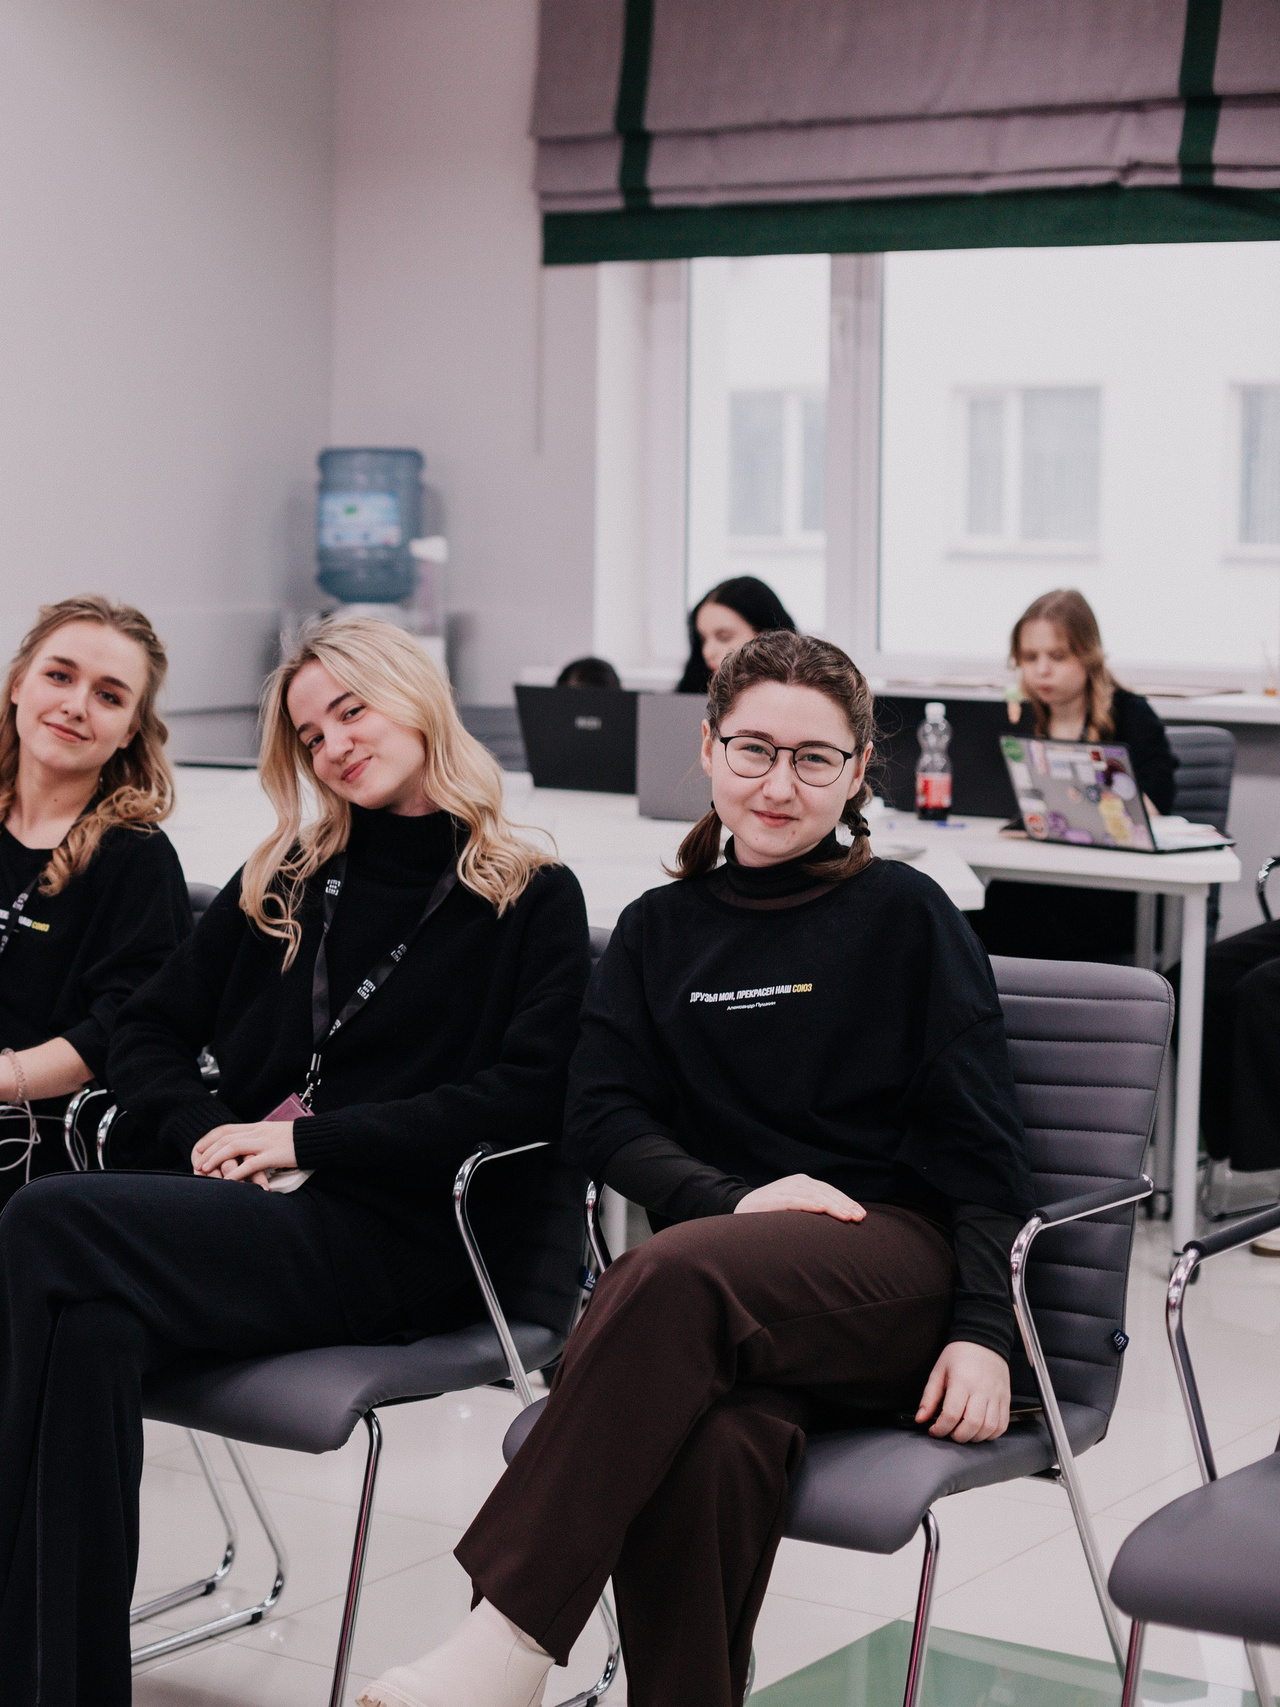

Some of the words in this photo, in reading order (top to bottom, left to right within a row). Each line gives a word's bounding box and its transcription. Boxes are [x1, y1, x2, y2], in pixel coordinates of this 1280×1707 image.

[690, 992, 718, 1003] ДРУЗЬЯ
[736, 987, 774, 999] ПРЕКРАСЕН
[775, 985, 791, 995] НАШ
[792, 984, 812, 993] СОЮЗ
